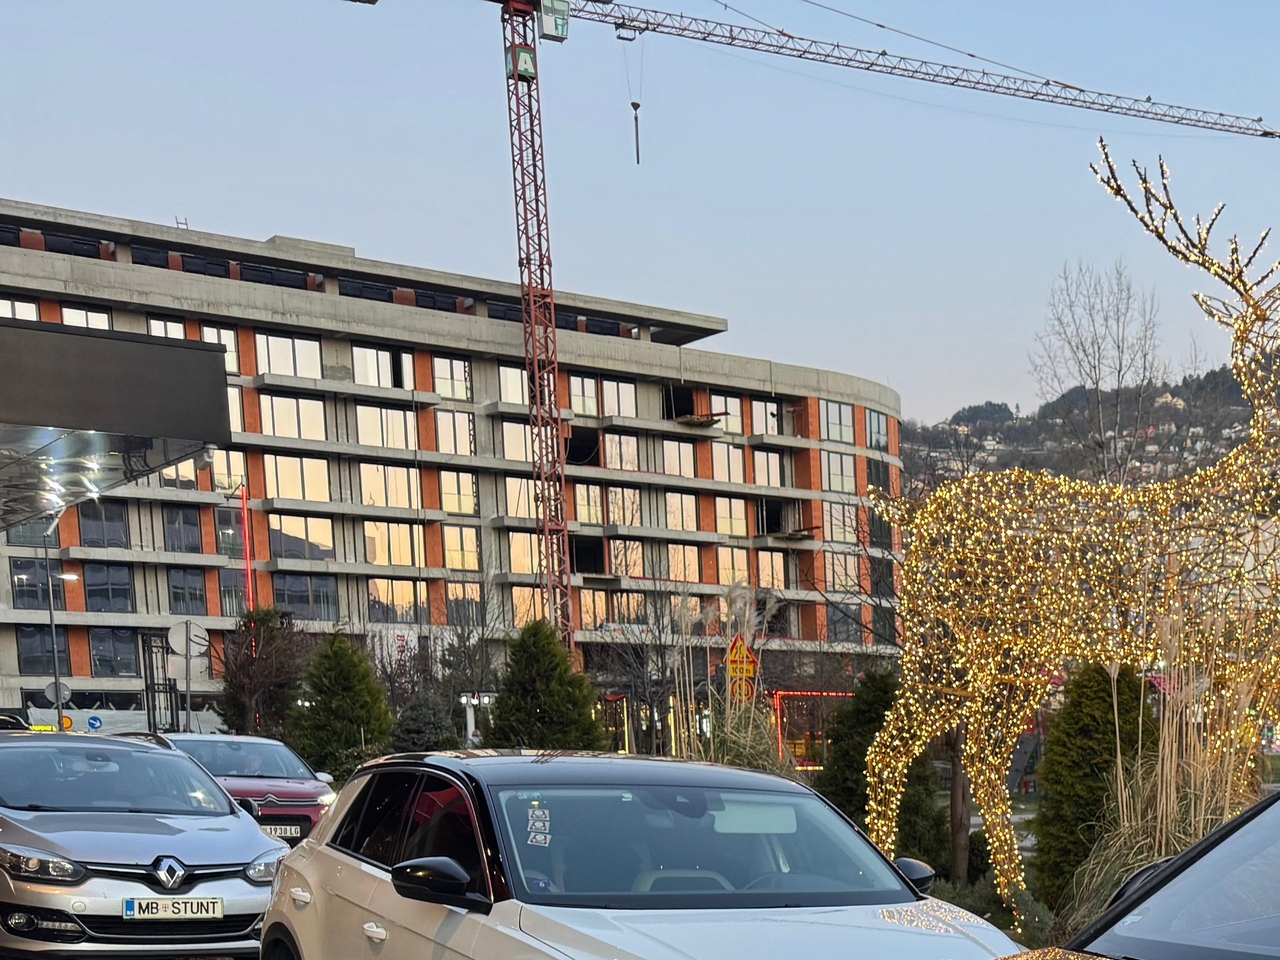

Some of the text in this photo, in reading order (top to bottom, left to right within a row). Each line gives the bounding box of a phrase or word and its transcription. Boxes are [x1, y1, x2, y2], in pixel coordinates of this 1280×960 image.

[518, 52, 535, 73] A
[138, 901, 218, 915] MB STUNT
